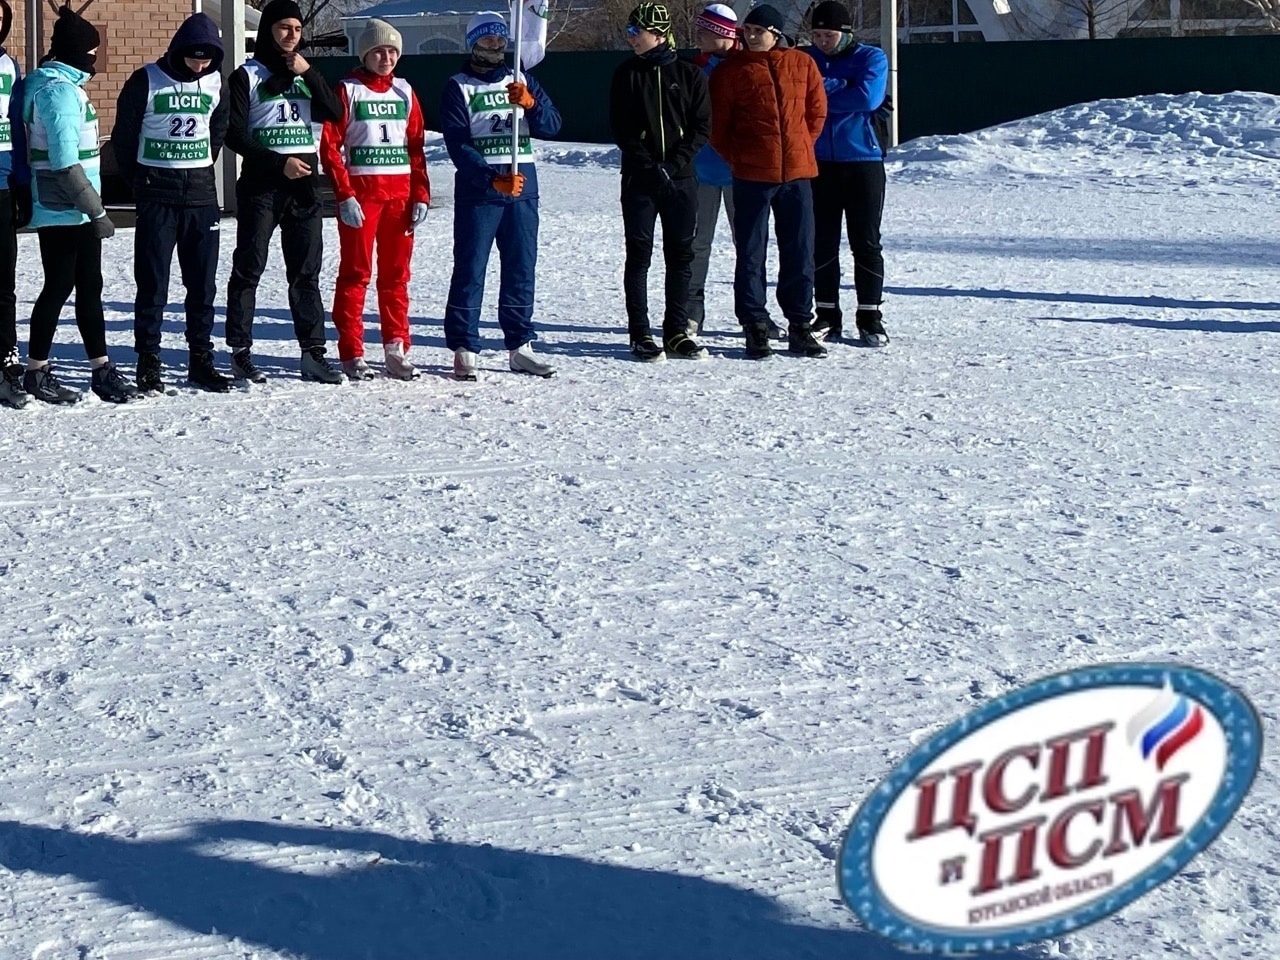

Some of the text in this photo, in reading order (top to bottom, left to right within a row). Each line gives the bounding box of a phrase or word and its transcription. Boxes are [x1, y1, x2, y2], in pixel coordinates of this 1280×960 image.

[168, 95, 201, 110] ЦСП
[367, 103, 398, 117] ЦСП
[278, 102, 300, 123] 18
[170, 117, 197, 137] 22
[380, 124, 390, 143] 1
[269, 137, 309, 145] ОБЛАСТЬ
[159, 151, 204, 159] ОБЛАСТЬ
